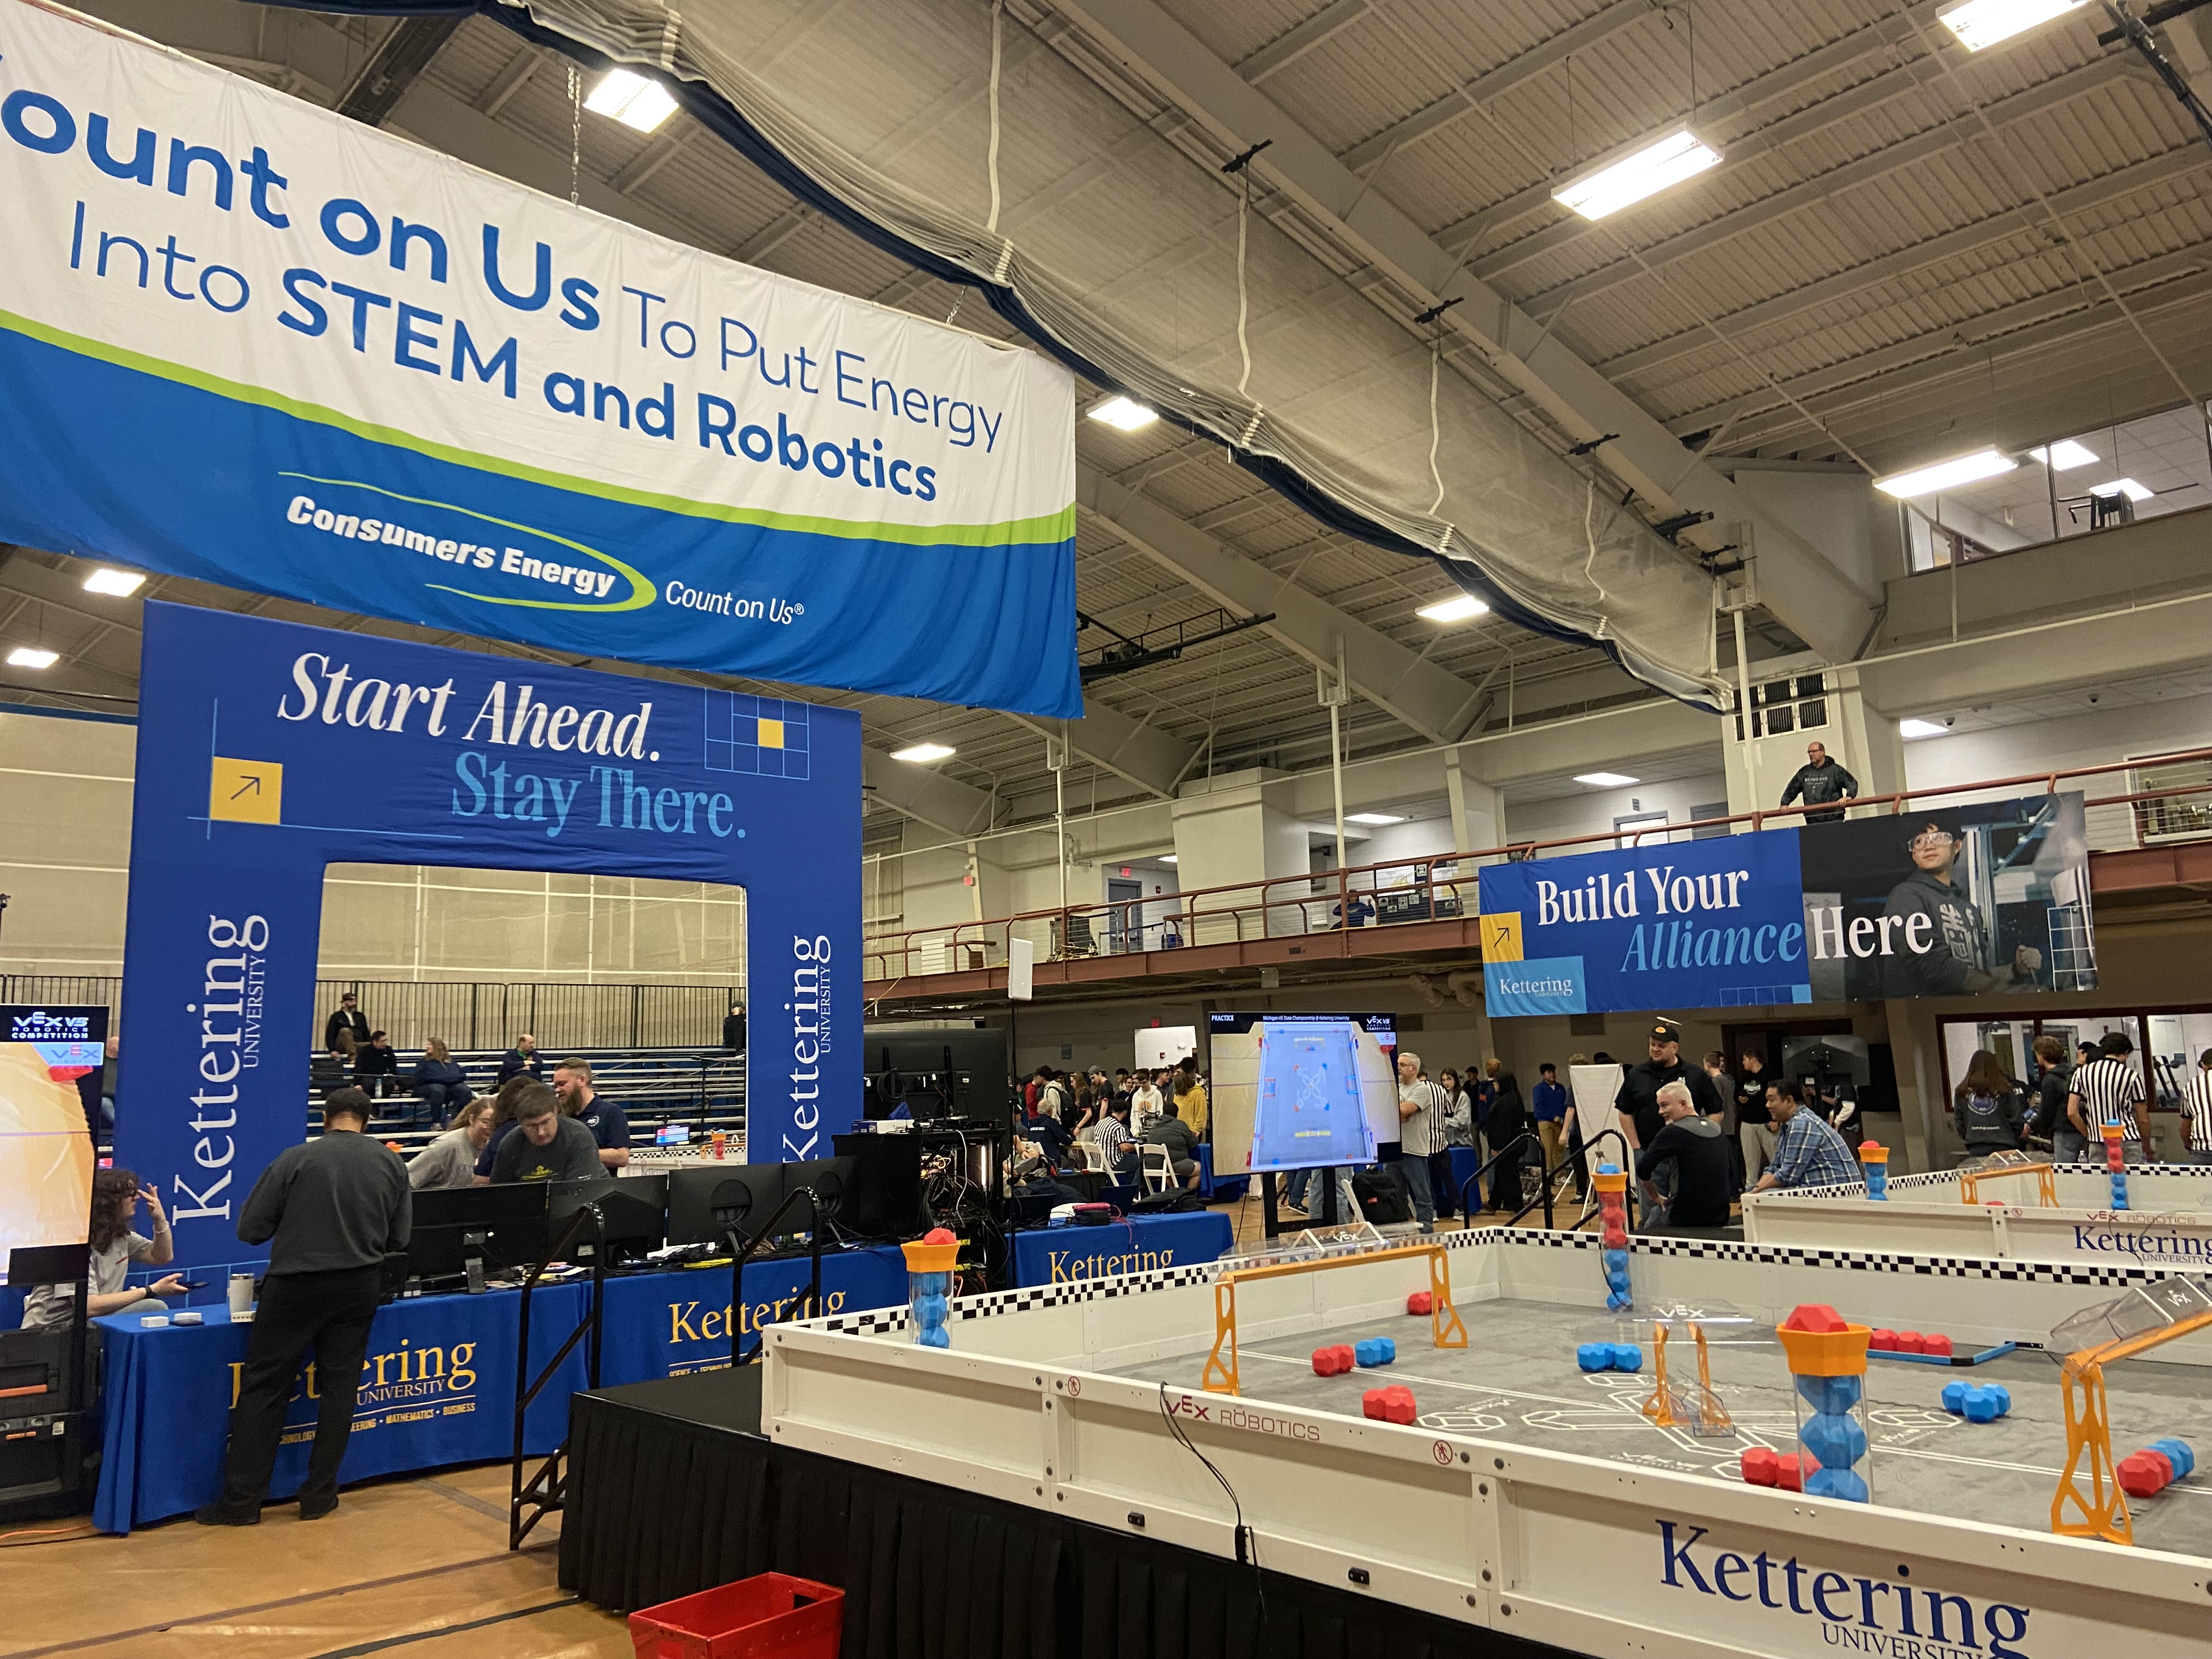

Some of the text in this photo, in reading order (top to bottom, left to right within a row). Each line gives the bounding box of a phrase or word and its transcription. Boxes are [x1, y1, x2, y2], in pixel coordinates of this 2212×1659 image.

[0, 54, 1003, 452] ount on Us To Put Energy
[70, 201, 936, 502] Into STEM and Robotics
[286, 495, 616, 597] Consumers Energy
[665, 580, 732, 616] Count
[735, 597, 764, 620] on
[276, 652, 661, 762] Start Ahead.
[451, 751, 746, 839] Stay There.
[1536, 865, 1749, 926] Build Your
[1620, 919, 1803, 972] Alliance
[1811, 905, 1933, 961] Here
[243, 955, 267, 1070] UNIVERSITY
[820, 966, 831, 1054] UNIVERSITY
[1499, 977, 1573, 996] Kettering
[13, 1011, 63, 1027] VEX
[782, 935, 831, 1163] Kettering
[1366, 1015, 1382, 1024] VEX
[51, 1044, 99, 1059] VEX
[172, 914, 269, 1226] Kettering
[2086, 1211, 2120, 1222] VEX
[2142, 1254, 2204, 1265] UNIVERSITY
[1658, 1305, 1707, 1318] VEX
[356, 1379, 445, 1406] UNIVERSITY
[386, 1409, 435, 1424] MATHEMATICS
[443, 1402, 476, 1416] BUSINESS
[1166, 1395, 1210, 1421] VEX
[1655, 1518, 2030, 1659] Kettering
